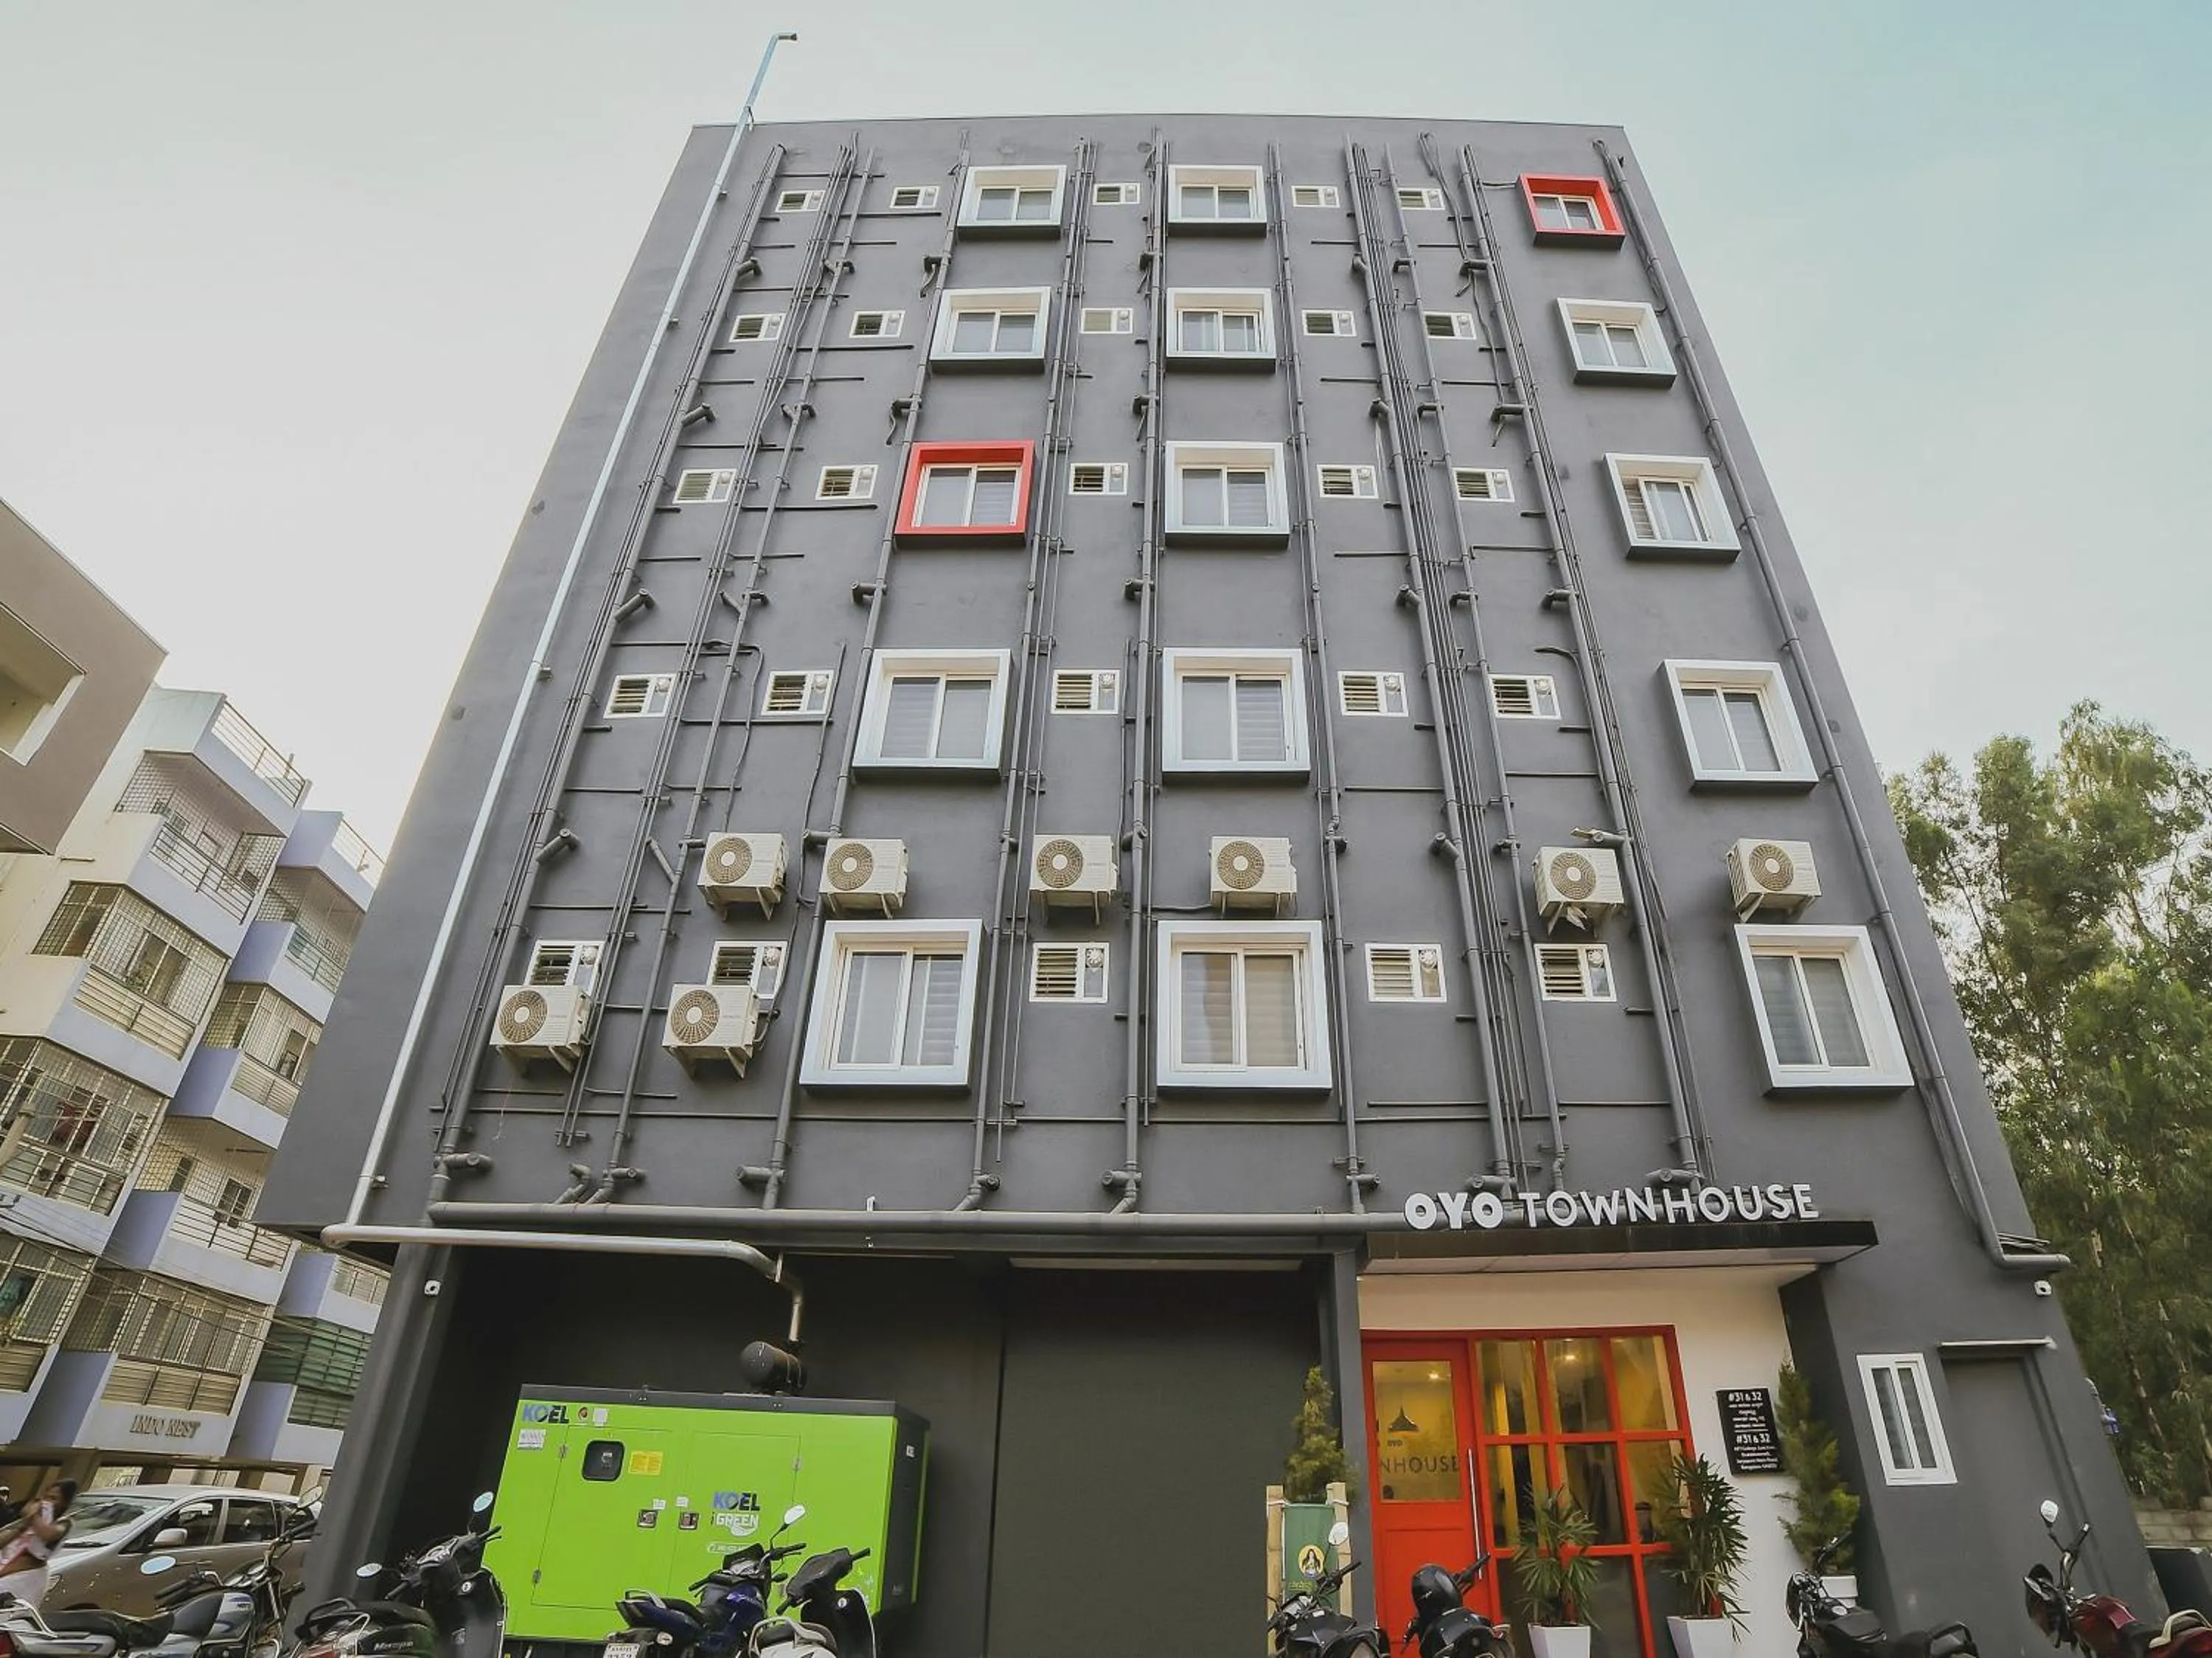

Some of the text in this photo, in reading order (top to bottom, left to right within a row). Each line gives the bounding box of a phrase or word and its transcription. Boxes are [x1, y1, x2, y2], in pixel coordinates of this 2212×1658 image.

[1404, 1184, 1819, 1229] OYO TOWNHOUSE
[1752, 1392, 1763, 1401] 32
[523, 1404, 569, 1423] KOEL
[1759, 1433, 1770, 1443] 32
[713, 1492, 760, 1510] KOEL
